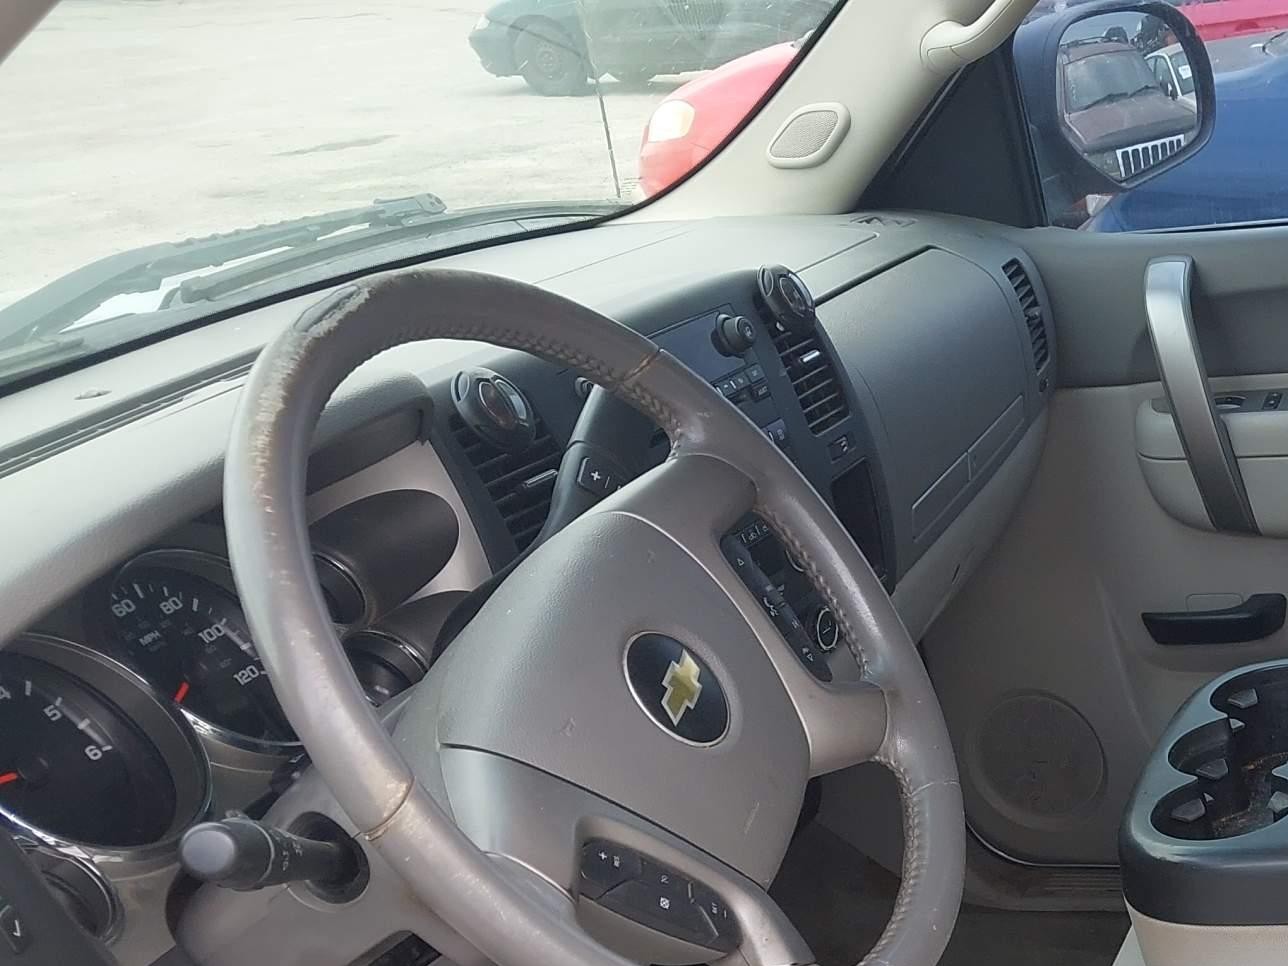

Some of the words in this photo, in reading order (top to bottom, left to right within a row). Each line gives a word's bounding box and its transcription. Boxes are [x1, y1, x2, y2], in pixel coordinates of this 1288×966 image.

[112, 599, 136, 617] 60
[160, 597, 183, 615] 80
[139, 630, 161, 646] MPH
[198, 624, 225, 644] 100
[233, 665, 260, 686] 120
[43, 704, 62, 721] 5
[84, 745, 103, 761] 6
